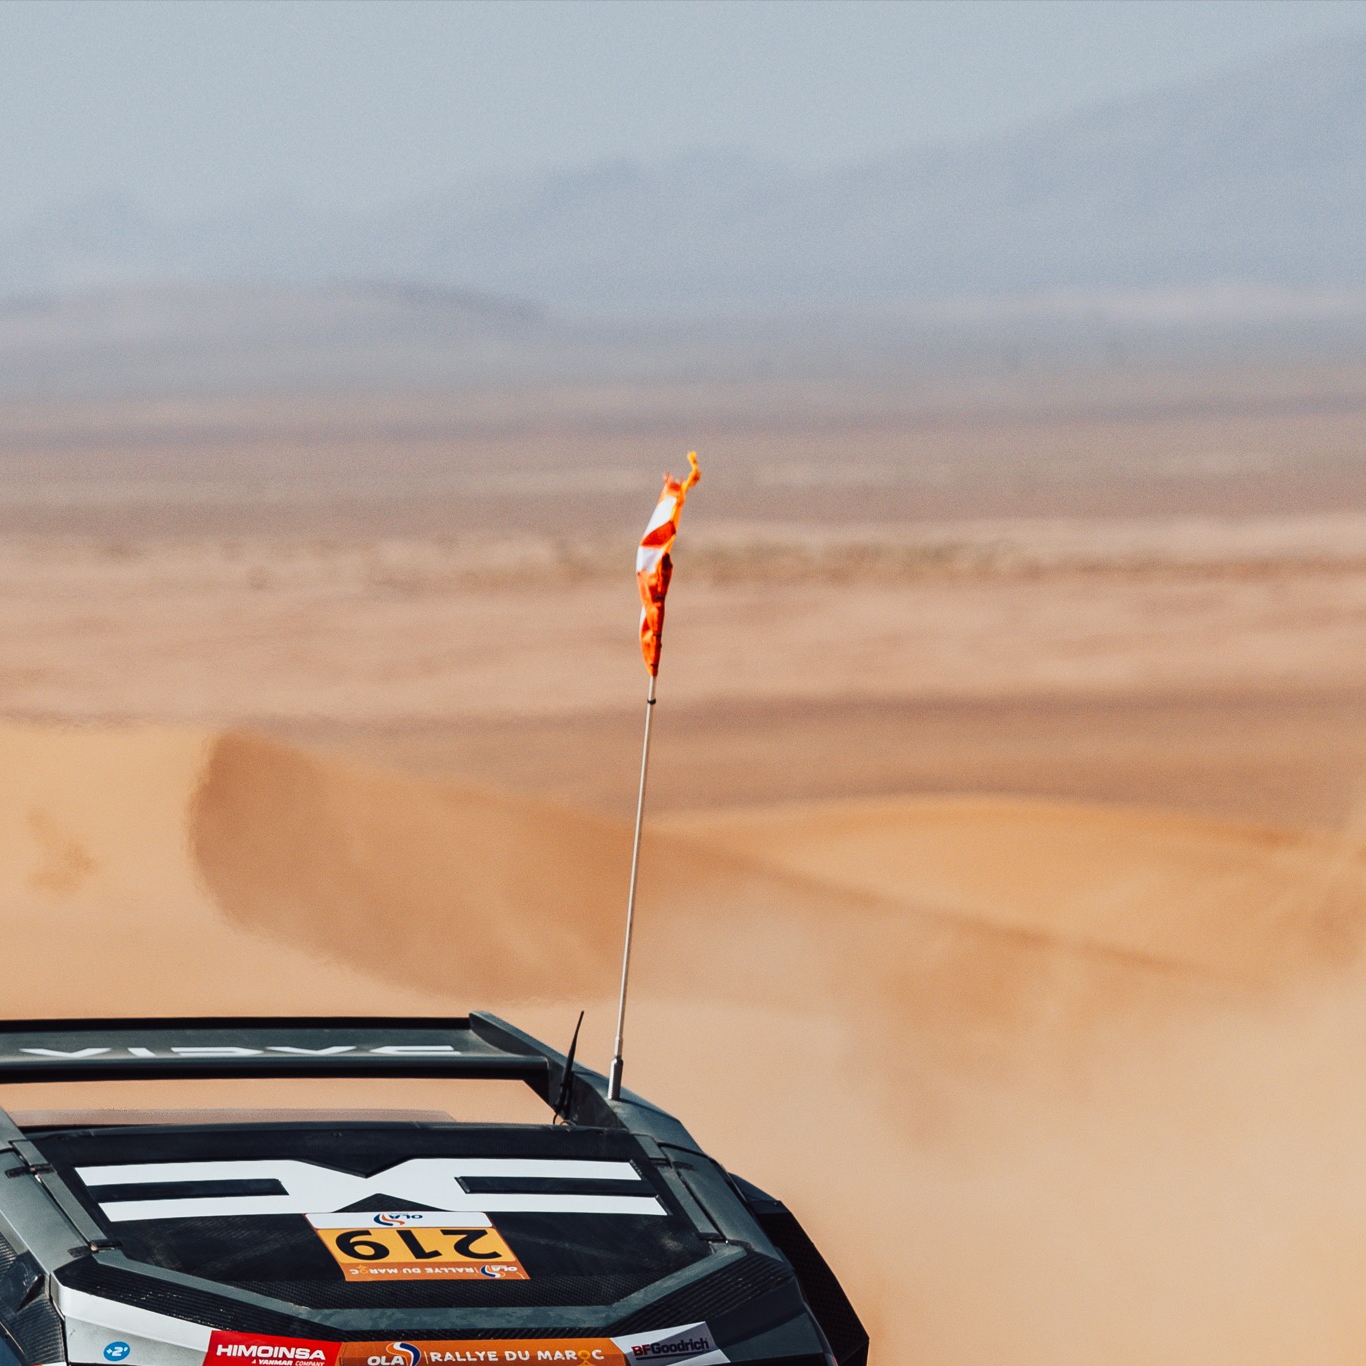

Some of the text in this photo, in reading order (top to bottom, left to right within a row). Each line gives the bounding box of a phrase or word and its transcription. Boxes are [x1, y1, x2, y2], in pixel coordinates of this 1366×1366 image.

[335, 1229, 503, 1261] 219
[216, 1344, 326, 1360] HIMOINSA
[631, 1338, 711, 1356] BFGoodrich
[367, 1355, 404, 1366] OLA
[430, 1351, 498, 1362] RALLYE
[504, 1350, 530, 1361] DU
